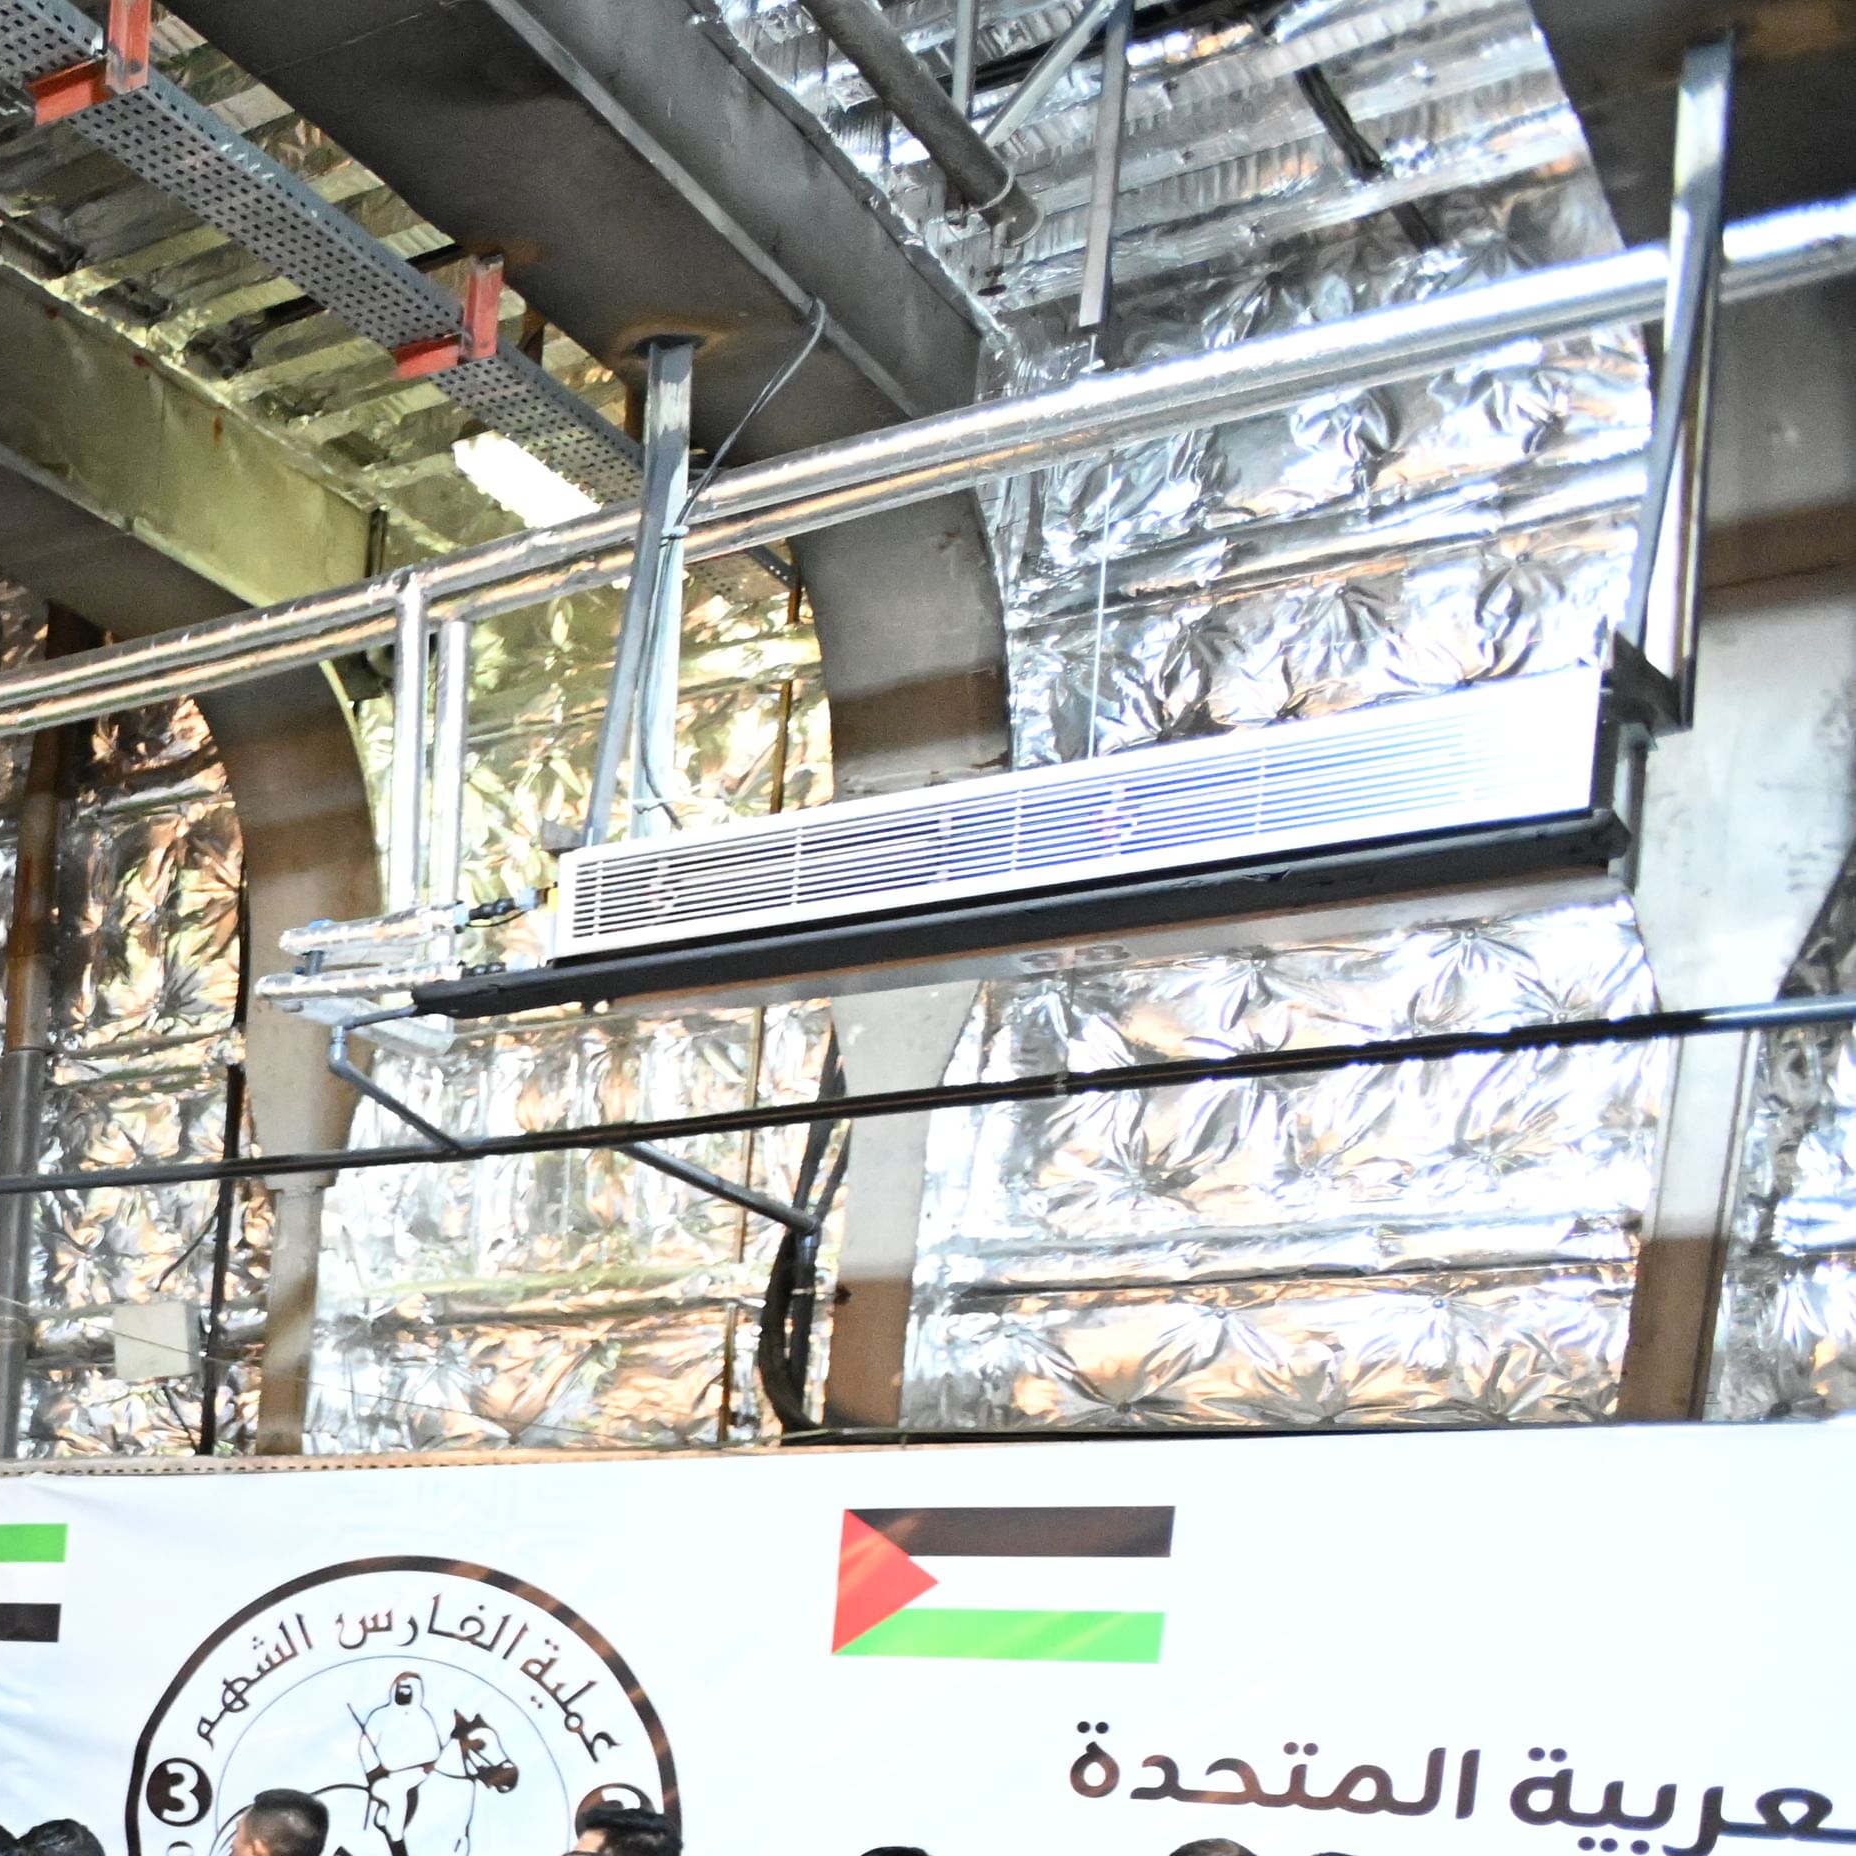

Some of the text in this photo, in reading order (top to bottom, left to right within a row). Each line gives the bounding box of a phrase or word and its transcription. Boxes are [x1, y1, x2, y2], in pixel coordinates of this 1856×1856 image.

[197, 1593, 622, 1764] عملية الفارس الشهم
[162, 1762, 200, 1823] 3
[1070, 1720, 1480, 1819] المتحدة
